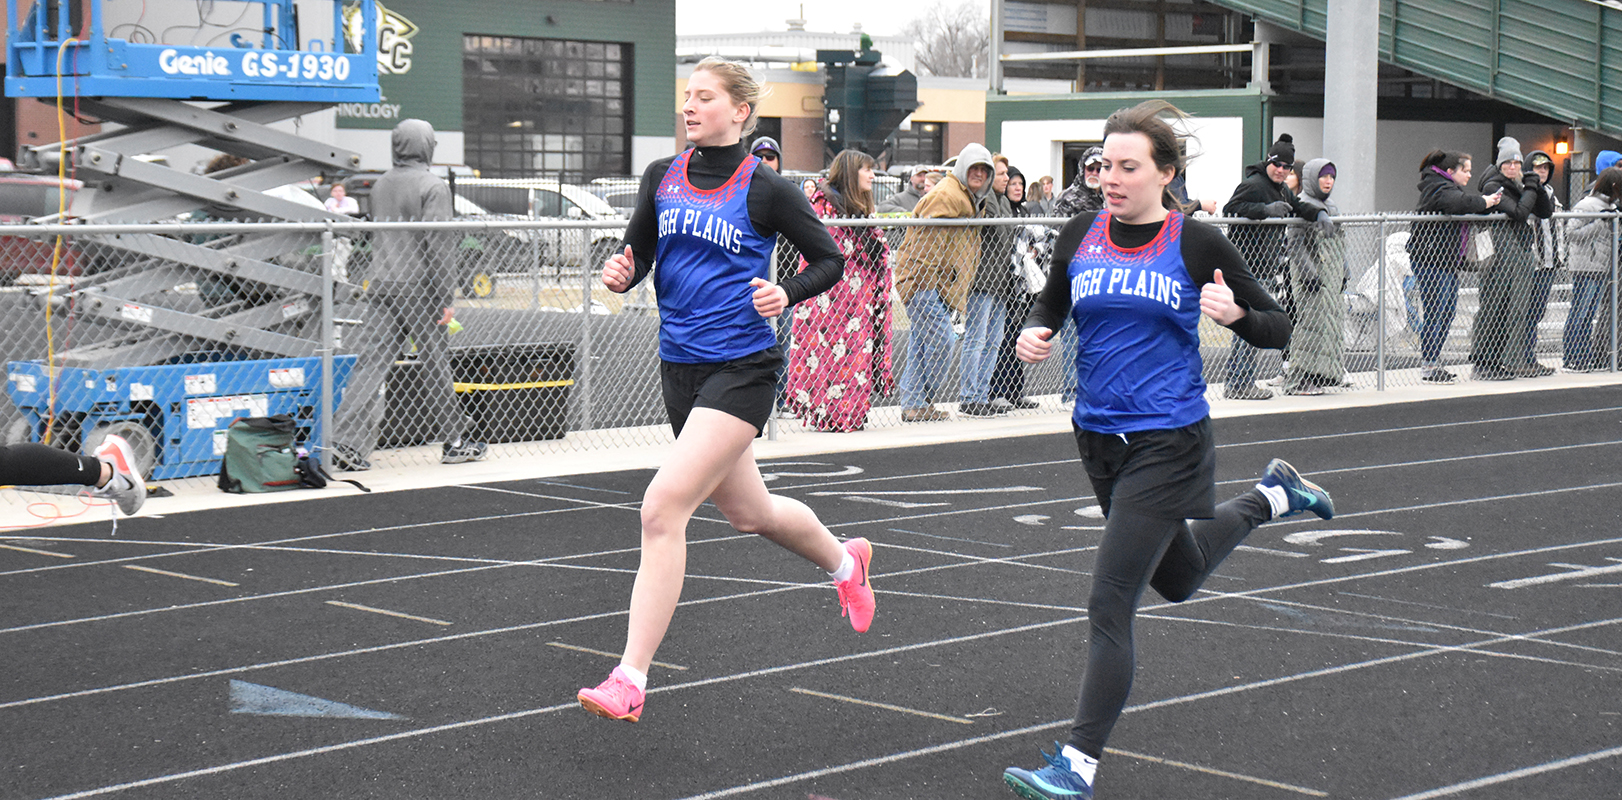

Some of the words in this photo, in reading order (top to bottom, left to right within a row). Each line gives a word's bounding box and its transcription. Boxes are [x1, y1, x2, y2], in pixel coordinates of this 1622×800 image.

[159, 49, 231, 76] Genie
[241, 51, 351, 81] GS-1930
[681, 208, 743, 254] PLAINS
[1071, 267, 1106, 307] HIGH
[1106, 267, 1182, 310] PLAINS
